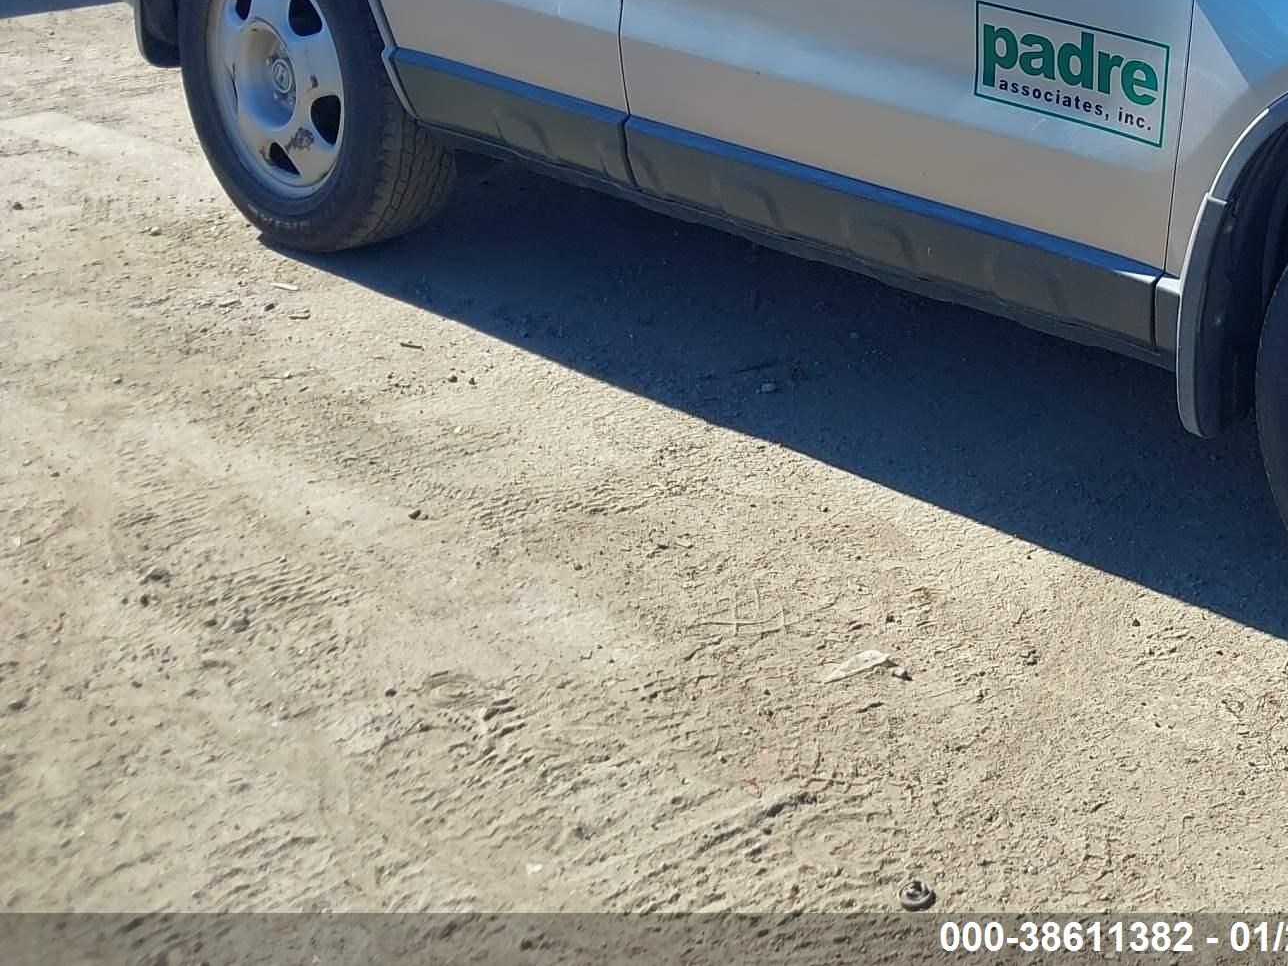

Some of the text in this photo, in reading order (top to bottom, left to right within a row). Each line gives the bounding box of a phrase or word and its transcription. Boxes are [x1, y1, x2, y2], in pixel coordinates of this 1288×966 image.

[982, 23, 1159, 106] padre
[999, 77, 1152, 131] associates, inc.
